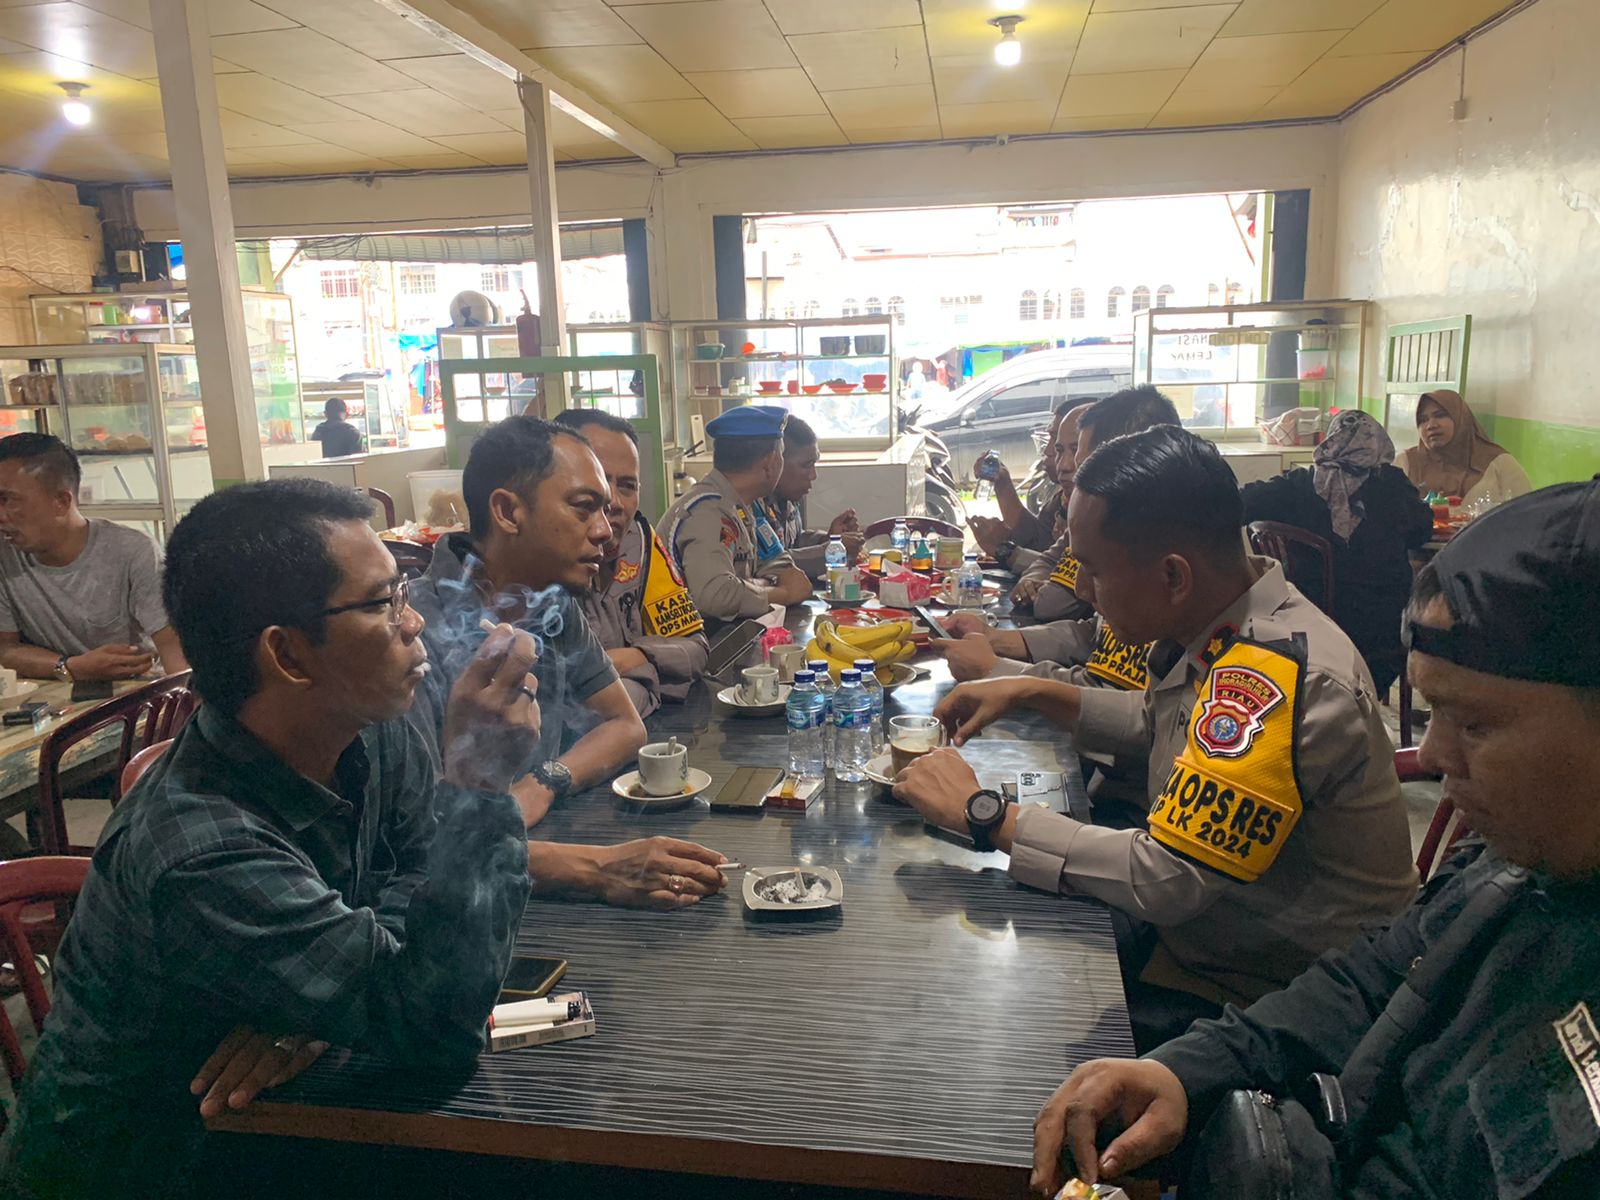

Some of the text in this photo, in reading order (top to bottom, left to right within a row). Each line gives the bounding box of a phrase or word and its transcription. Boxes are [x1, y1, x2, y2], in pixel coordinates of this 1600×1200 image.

[660, 620, 681, 635] OPS
[1108, 660, 1146, 686] PRAJA
[1222, 672, 1271, 696] POLRES
[1221, 690, 1255, 708] RIAU
[1167, 805, 1193, 832] LK
[1196, 821, 1252, 859] 2024
